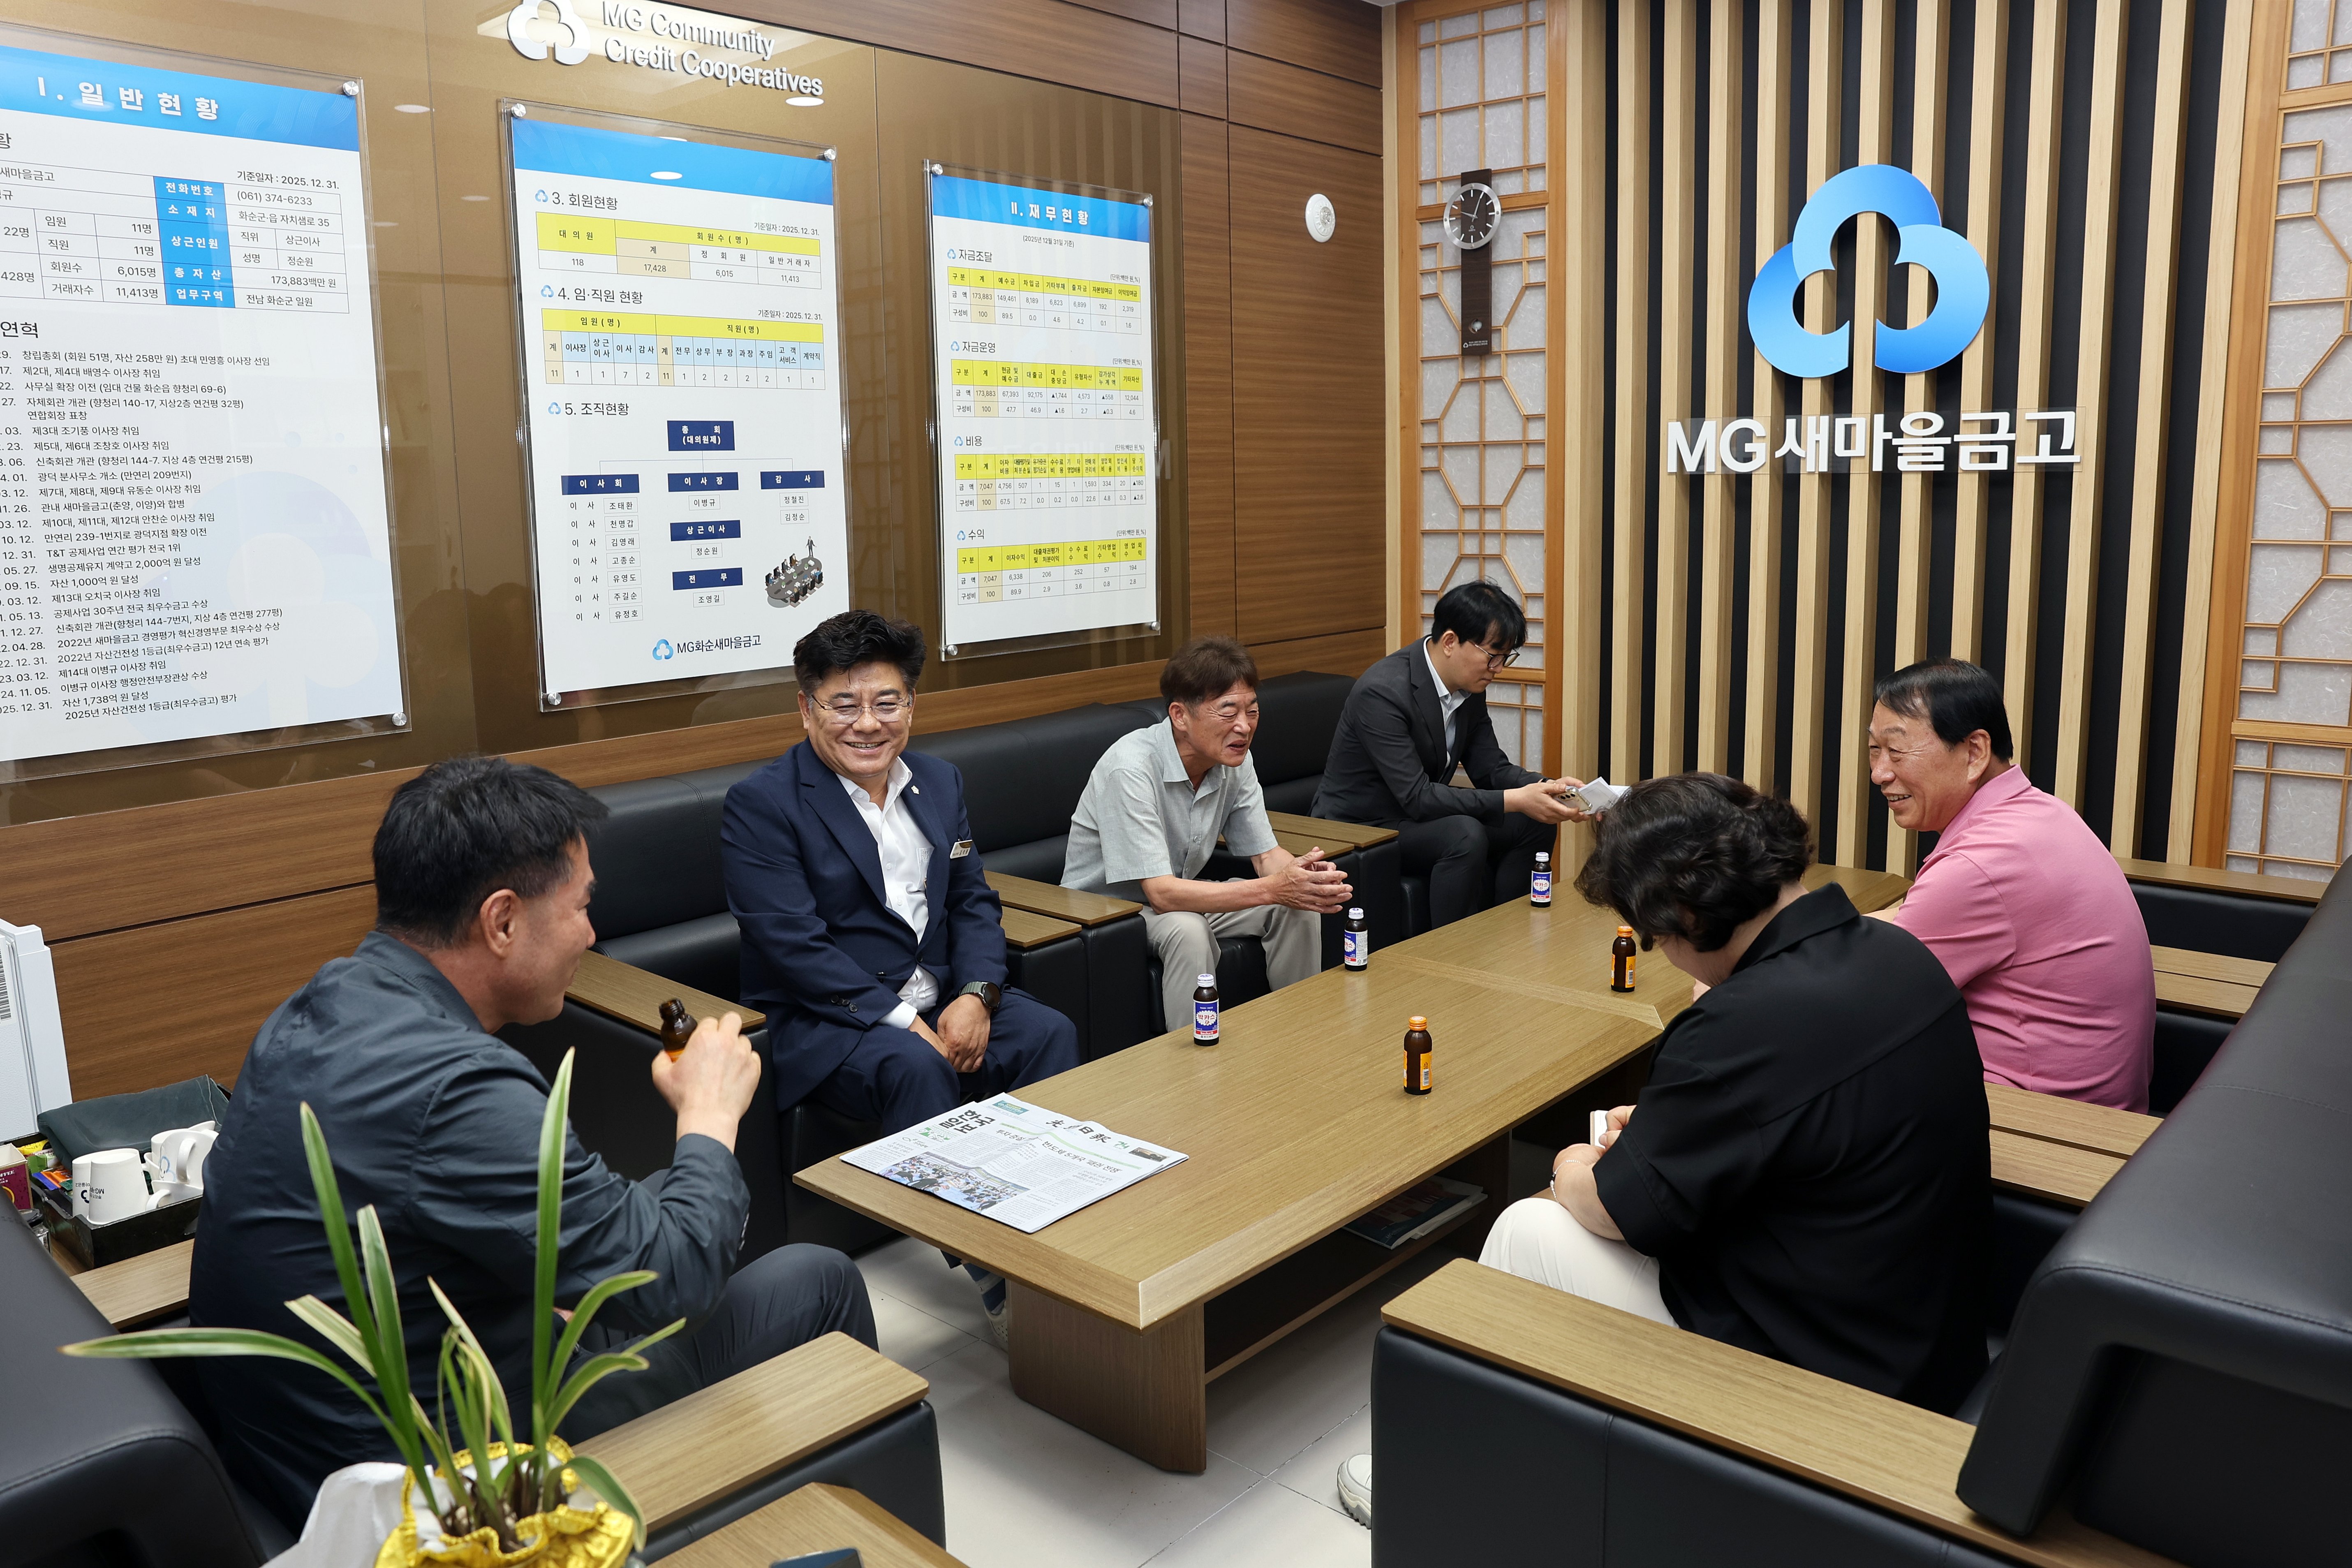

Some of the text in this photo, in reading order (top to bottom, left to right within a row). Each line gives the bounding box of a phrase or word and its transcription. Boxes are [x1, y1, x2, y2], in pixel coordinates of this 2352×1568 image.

[603, 1, 775, 61] MG Community
[605, 37, 823, 97] Credit Cooperatives
[237, 171, 273, 183] 기준일자
[281, 176, 308, 186] 2025.
[311, 179, 324, 187] 12.
[326, 180, 339, 189] 31.
[166, 182, 213, 196] 전화번호
[237, 190, 312, 206] (061) 374-6233
[552, 192, 618, 210] 3. 회원현황
[168, 204, 215, 218] 소재지
[1029, 204, 1088, 225] 재무현황
[45, 216, 67, 227] 임원
[280, 215, 315, 226] 자치샘로
[317, 218, 329, 227] 35
[3, 227, 29, 238] 22명
[132, 224, 151, 234] 11명
[754, 222, 777, 232] 기준일자
[782, 225, 800, 234] 2025.
[241, 231, 259, 242] 직위
[559, 229, 593, 241] 대의원
[1023, 235, 1042, 243] (2025년
[48, 239, 69, 250] 직원
[171, 236, 218, 249] 상근인원
[285, 235, 320, 247] 상근이사
[134, 246, 154, 256] 11명
[959, 249, 992, 263] 자금조달
[243, 253, 260, 264] 성명
[287, 256, 313, 267] 정순원
[50, 261, 82, 273] 회원수
[118, 266, 156, 278] 6,015명
[644, 264, 666, 273] 17,428
[174, 267, 221, 280] 총자산
[716, 269, 733, 278] 6,015
[781, 275, 800, 283] 11,413
[271, 275, 336, 288] 173,883백만 원
[52, 283, 94, 295] 거래자수
[116, 287, 158, 298] 11,413명
[176, 289, 223, 301] 업무구역
[246, 294, 313, 307] 전남 화순군 일원
[558, 287, 643, 304] 4. 임·직원 현황
[972, 292, 992, 301] 173,883
[997, 294, 1016, 303] 149,461
[953, 309, 968, 317] 구성비
[0, 321, 38, 338] 연혁
[565, 343, 587, 352] 이사장
[962, 341, 995, 353] 자금운영
[22, 350, 61, 361] 창립총회
[64, 352, 86, 362] (회원
[90, 353, 112, 363] 51명,
[115, 353, 133, 363] 자산
[136, 354, 163, 363] 258만
[165, 354, 177, 365] 원)
[180, 355, 197, 364] 초대
[227, 356, 252, 365] 이사장
[254, 357, 270, 366] 선임
[803, 352, 820, 361] 계약직
[25, 382, 226, 395] 사무실 확장 이전 (임대 건물 화순읍 향청리 69-6)
[565, 402, 629, 416] 5. 조직현황
[28, 411, 87, 421] 연합회장 표창
[682, 435, 721, 445] (대의원제)
[966, 435, 982, 446] 비용
[1667, 411, 2081, 473] MG새마을금고
[694, 499, 715, 507] 이병규
[784, 496, 804, 504] 정철진
[609, 502, 633, 510] 조태환
[785, 513, 805, 521] 김정순
[610, 519, 634, 528] 천명갑
[687, 525, 725, 534] 상근이사
[968, 529, 984, 540] 수익
[46, 543, 180, 557] T&T 공제사업 연간 평가 전국 1위
[612, 556, 636, 564] 고종순
[1006, 553, 1025, 562] 이자수익
[50, 574, 139, 588] 자산 1,000억 원 달성
[1009, 573, 1023, 581] 6,338
[614, 592, 637, 601] 주길순
[698, 594, 719, 604] 조영길
[615, 610, 638, 619] 유정호
[57, 622, 280, 648] 2022년 새마을금고 경영평가 혁신경영부문 최우수상 수상
[677, 635, 761, 654] MG화순새마을금고
[65, 694, 237, 720] 2025년 자산건전성 1등급(최우수금고) 평가
[958, 1110, 996, 1126] 한국
